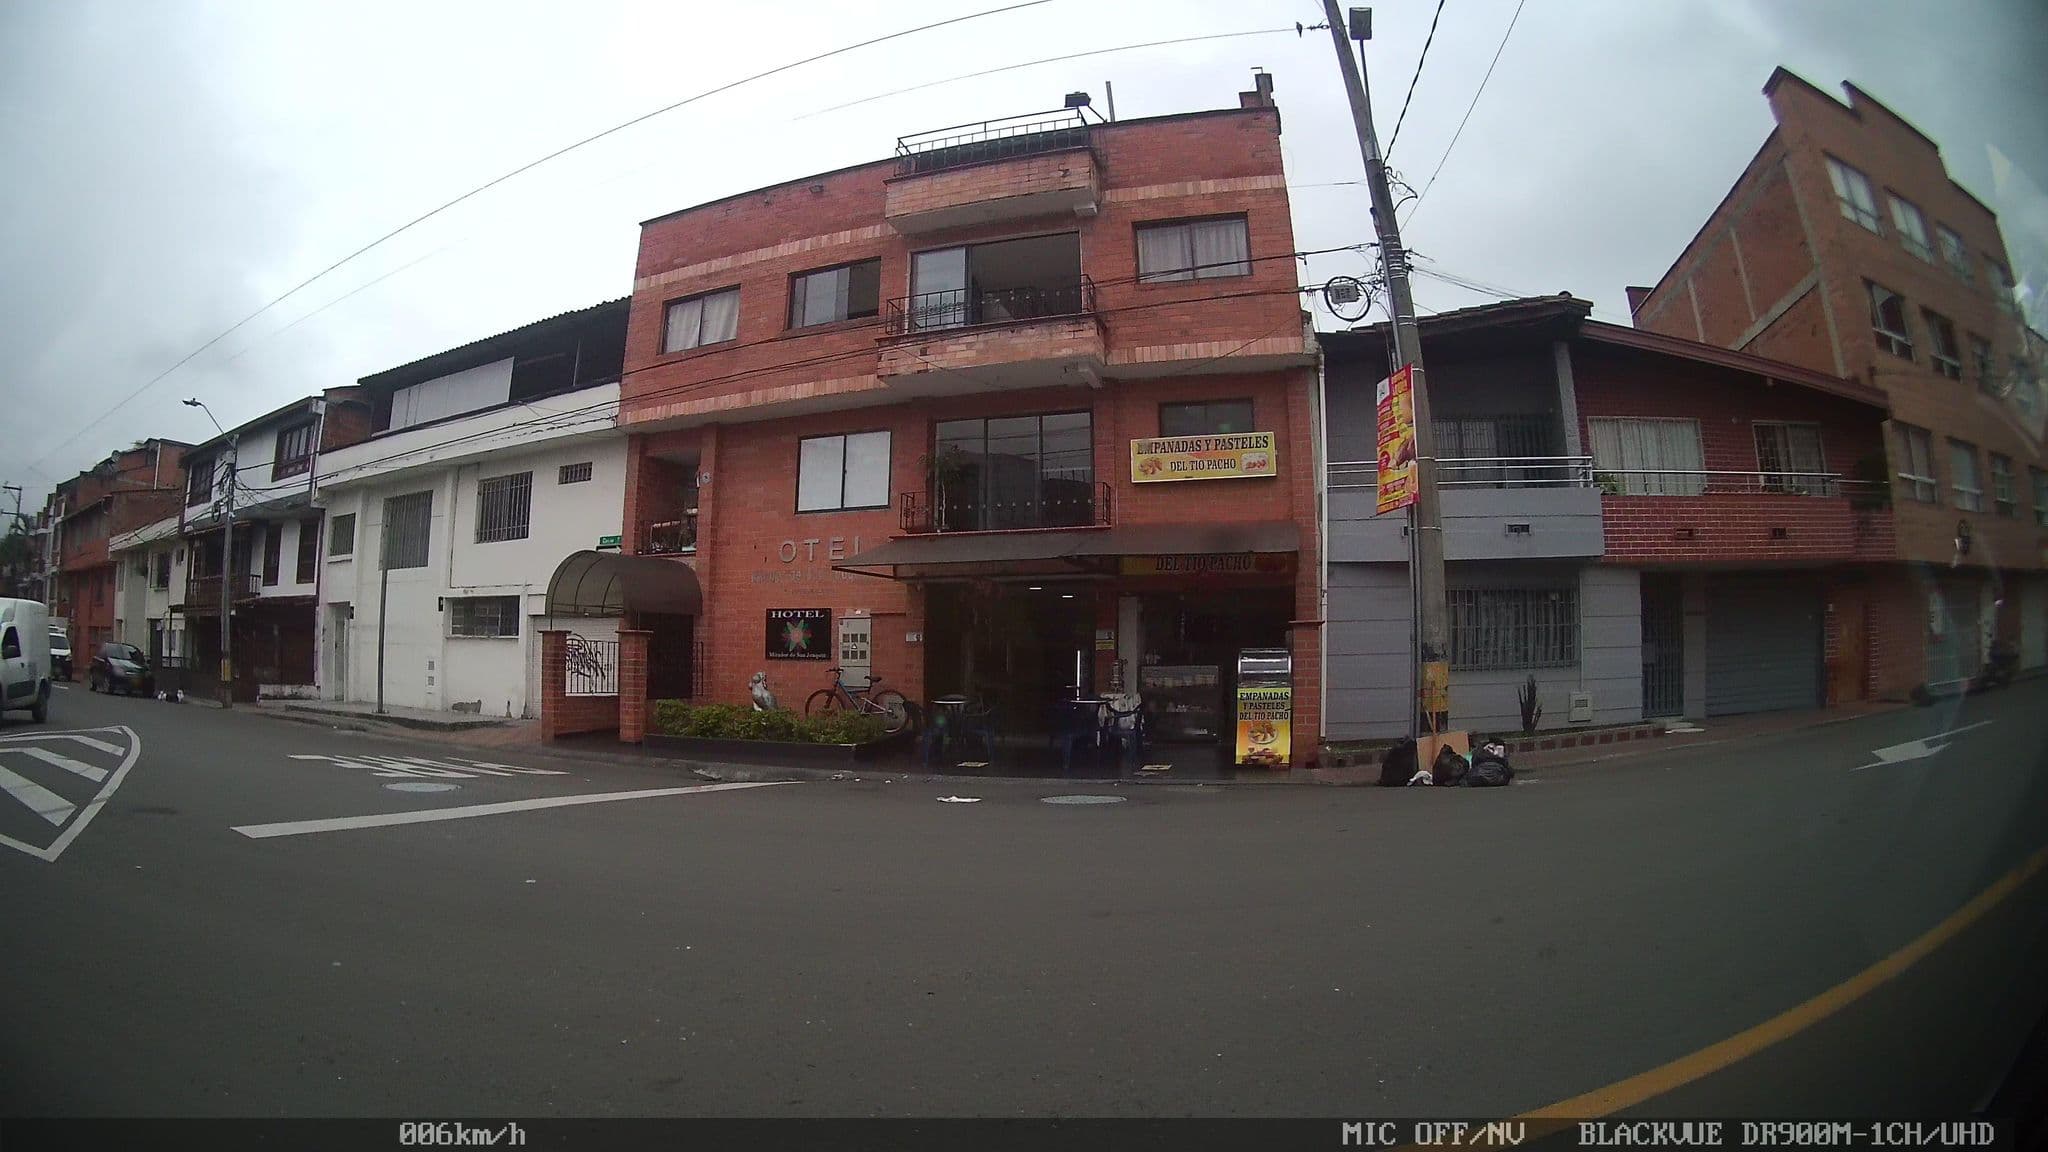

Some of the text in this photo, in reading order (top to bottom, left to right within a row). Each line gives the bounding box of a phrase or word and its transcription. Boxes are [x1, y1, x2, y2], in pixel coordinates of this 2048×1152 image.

[1137, 435, 1269, 455] EMPANADAS Y PASTELES
[1170, 457, 1237, 472] DEL TIO PACHO
[1155, 553, 1250, 571] DEL TIO PACHO
[771, 610, 825, 618] HOTEL
[1239, 691, 1289, 701] EMPANADAS
[1243, 701, 1285, 710] Y PASTELES
[1239, 711, 1289, 720] DEL TIO PACHO
